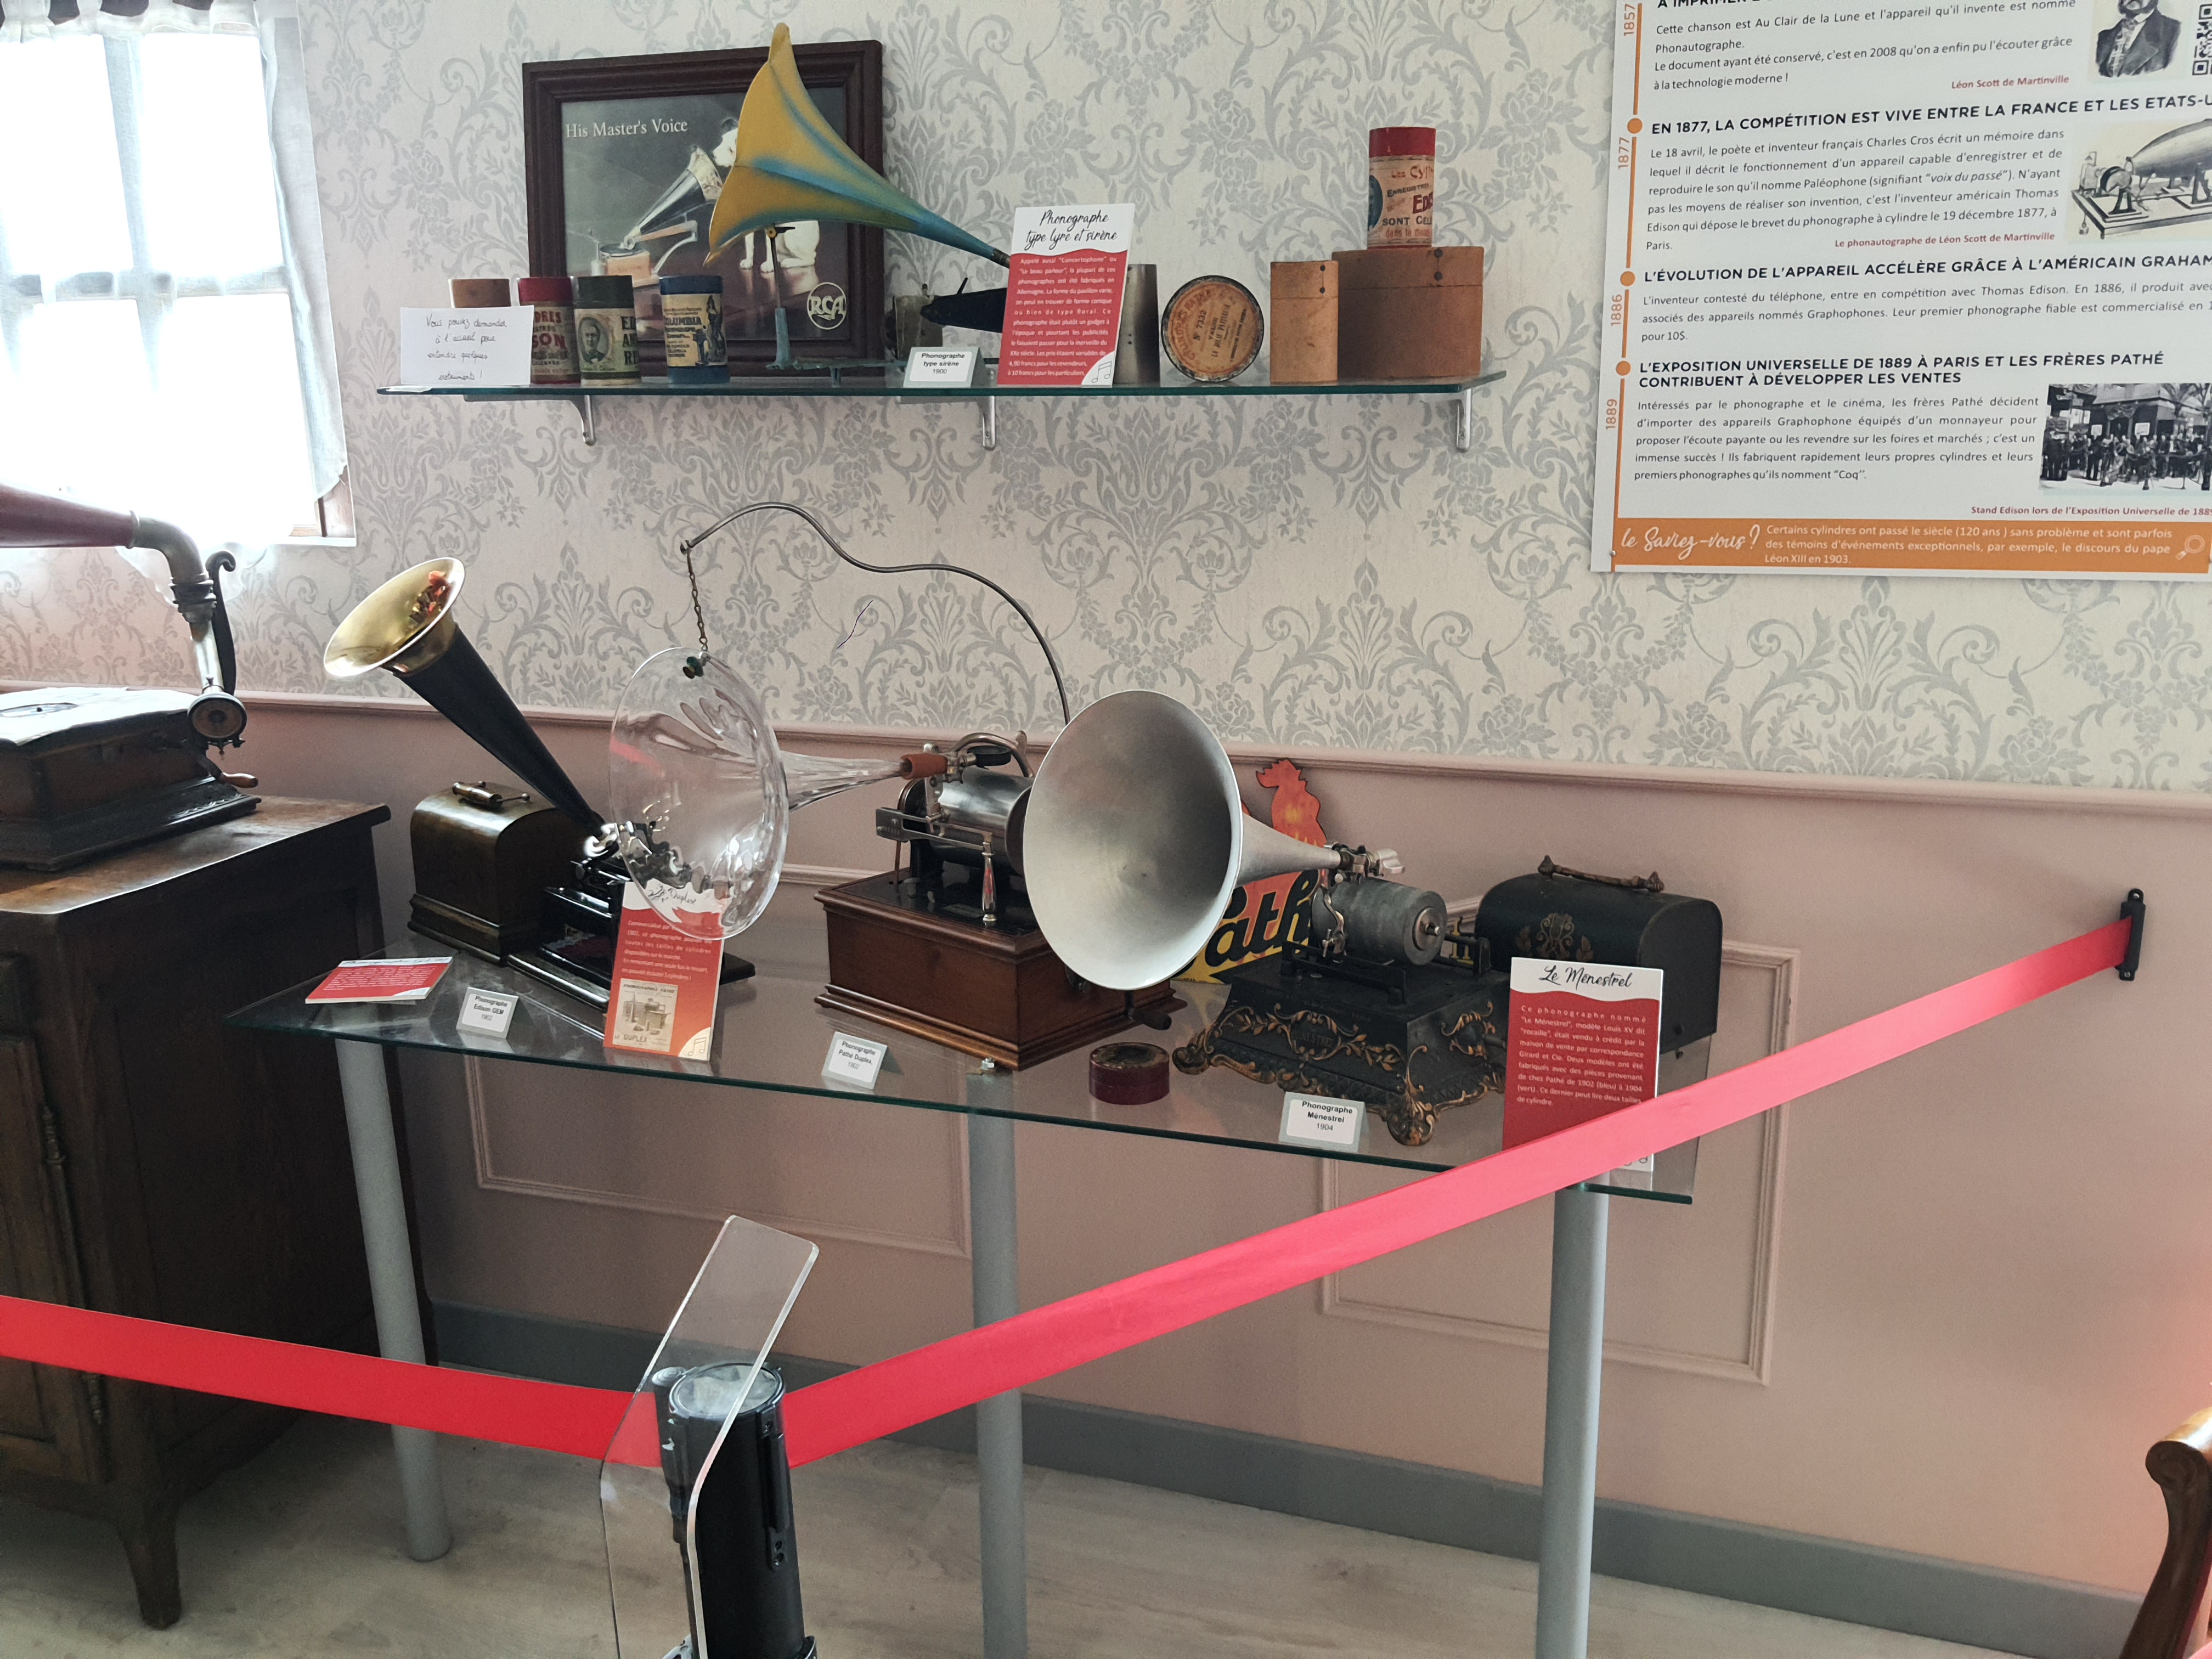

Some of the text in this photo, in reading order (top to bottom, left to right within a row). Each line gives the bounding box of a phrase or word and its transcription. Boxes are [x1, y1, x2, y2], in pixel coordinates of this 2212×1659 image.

[1624, 3, 1635, 36] 1857
[1654, 81, 1659, 90] à
[1662, 80, 1669, 89] la
[1673, 77, 1733, 89] technologie
[1735, 74, 1782, 84] moderne
[1952, 75, 2069, 89] Léon Scott de Martinville
[1652, 123, 1671, 134] EN
[1677, 121, 1709, 133] 1877,
[1716, 119, 1734, 131] LA
[1740, 114, 1846, 129] COMPÉTITION
[1852, 111, 1880, 123] EST
[1886, 109, 1921, 121] VIVE
[1928, 106, 1979, 120] ENTRE
[1985, 105, 2005, 116] LA
[2012, 101, 2078, 115] FRANCE
[2085, 100, 2104, 111] ET
[2110, 98, 2138, 111] LES
[566, 118, 688, 138] His Master's Voice
[1618, 137, 1629, 170] 1877
[1040, 209, 1109, 232] Phonographe
[1383, 218, 1410, 226] SONT
[1024, 228, 1119, 251] type lyre et sirène
[1647, 241, 1672, 250] Paris.
[1645, 255, 2212, 282] L'ÉVOLUTION DE L'APPAREIL ACCÉLÈRE GRÂCE À L'AMÉRICAIN GRAHAM
[809, 295, 845, 320] RCA
[1611, 294, 1622, 326] 1886
[427, 313, 507, 329] Vous pouvez demander
[1196, 309, 1207, 329] 7332
[481, 336, 496, 345] pour
[1642, 331, 1687, 343] pour 10$.
[1640, 351, 2163, 373] L'EXPOSITION UNIVERSELLE DE 1889 À PARIS ET LES FRÈRES PATHÉ
[1640, 373, 1961, 387] CONTRIBUENT À DÉVELOPPER LES VENTES
[1606, 399, 1618, 430] 1889
[1635, 471, 1677, 481] premiers
[1679, 471, 1750, 481] phonographes
[1753, 470, 1779, 480] qu'ils
[1765, 554, 1788, 563] Léon
[668, 888, 696, 905] Duplex
[1538, 965, 1633, 991] Le Ménestrel
[475, 996, 508, 1007] Phonographe
[842, 1041, 876, 1056] Phonographe
[1590, 1048, 1644, 1058] correspondance
[1302, 1101, 1353, 1114] Phonographe
[1307, 1111, 1345, 1123] Ménestrel
